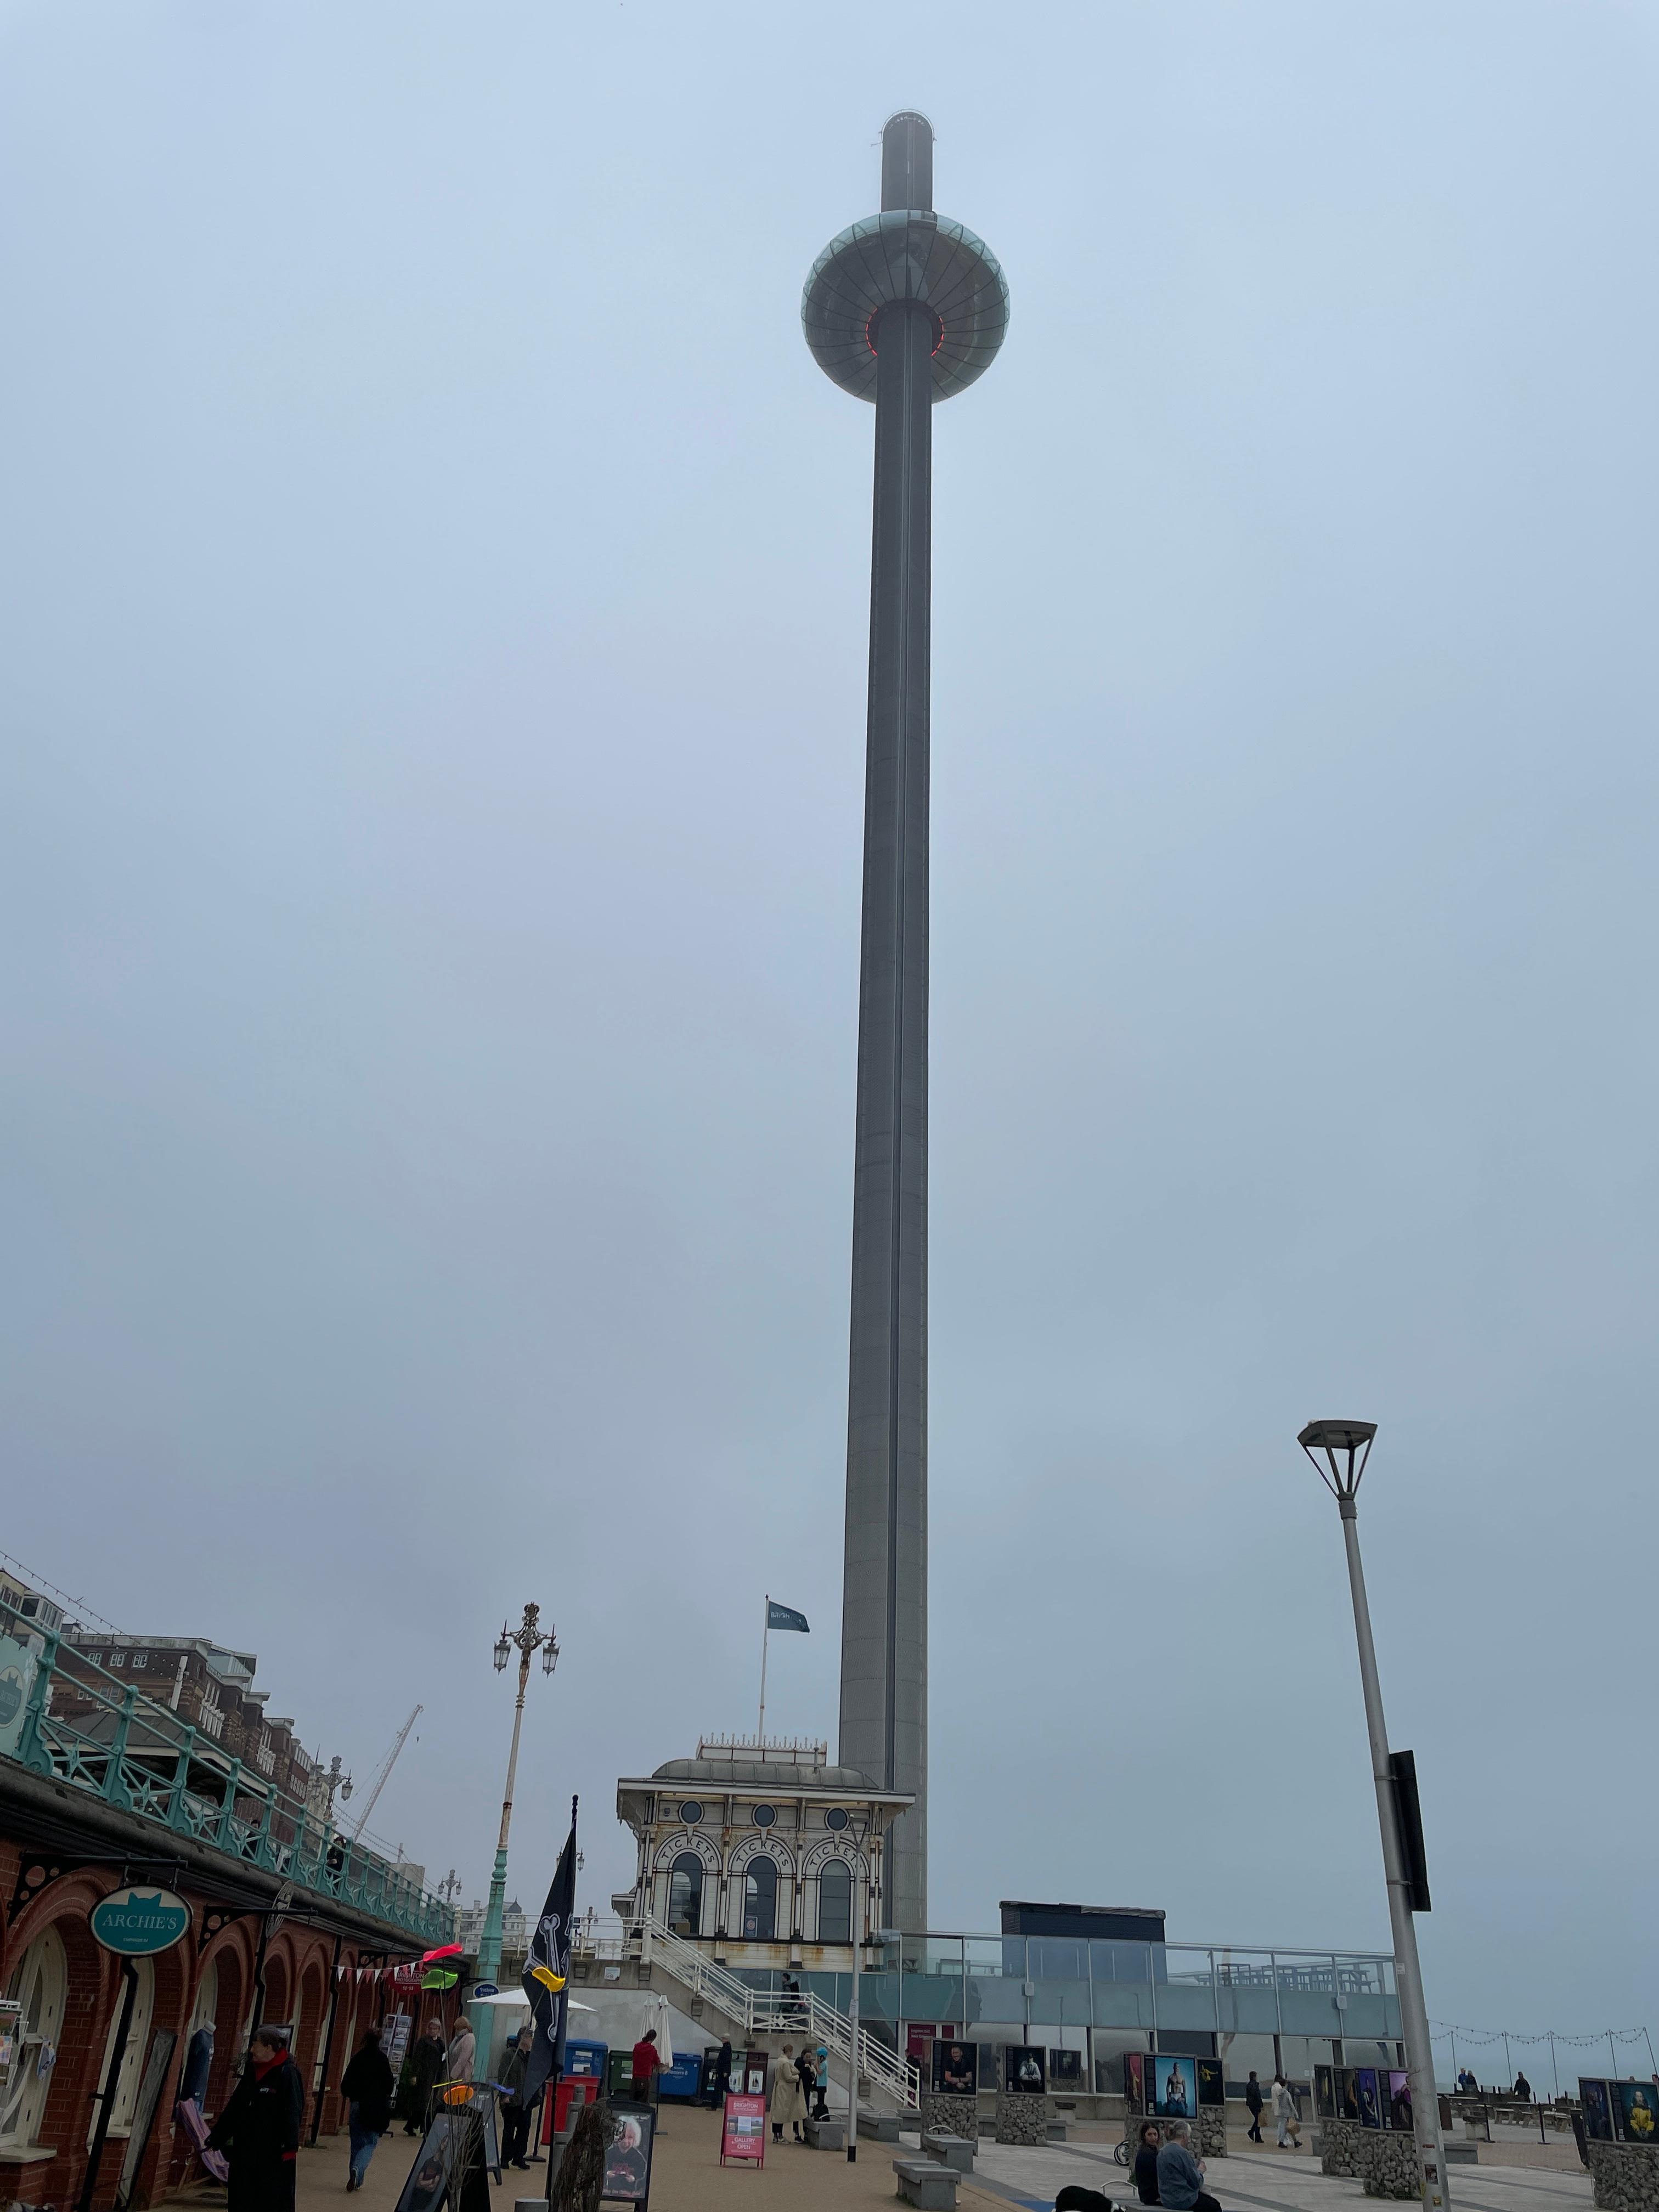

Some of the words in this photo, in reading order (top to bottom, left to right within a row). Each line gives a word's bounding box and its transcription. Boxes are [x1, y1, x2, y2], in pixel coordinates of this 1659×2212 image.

[662, 1838, 715, 1863] TICKETS
[736, 1841, 789, 1866] TICKETS
[810, 1844, 862, 1868] TICKET
[102, 1914, 177, 1929] ARCHIE'S
